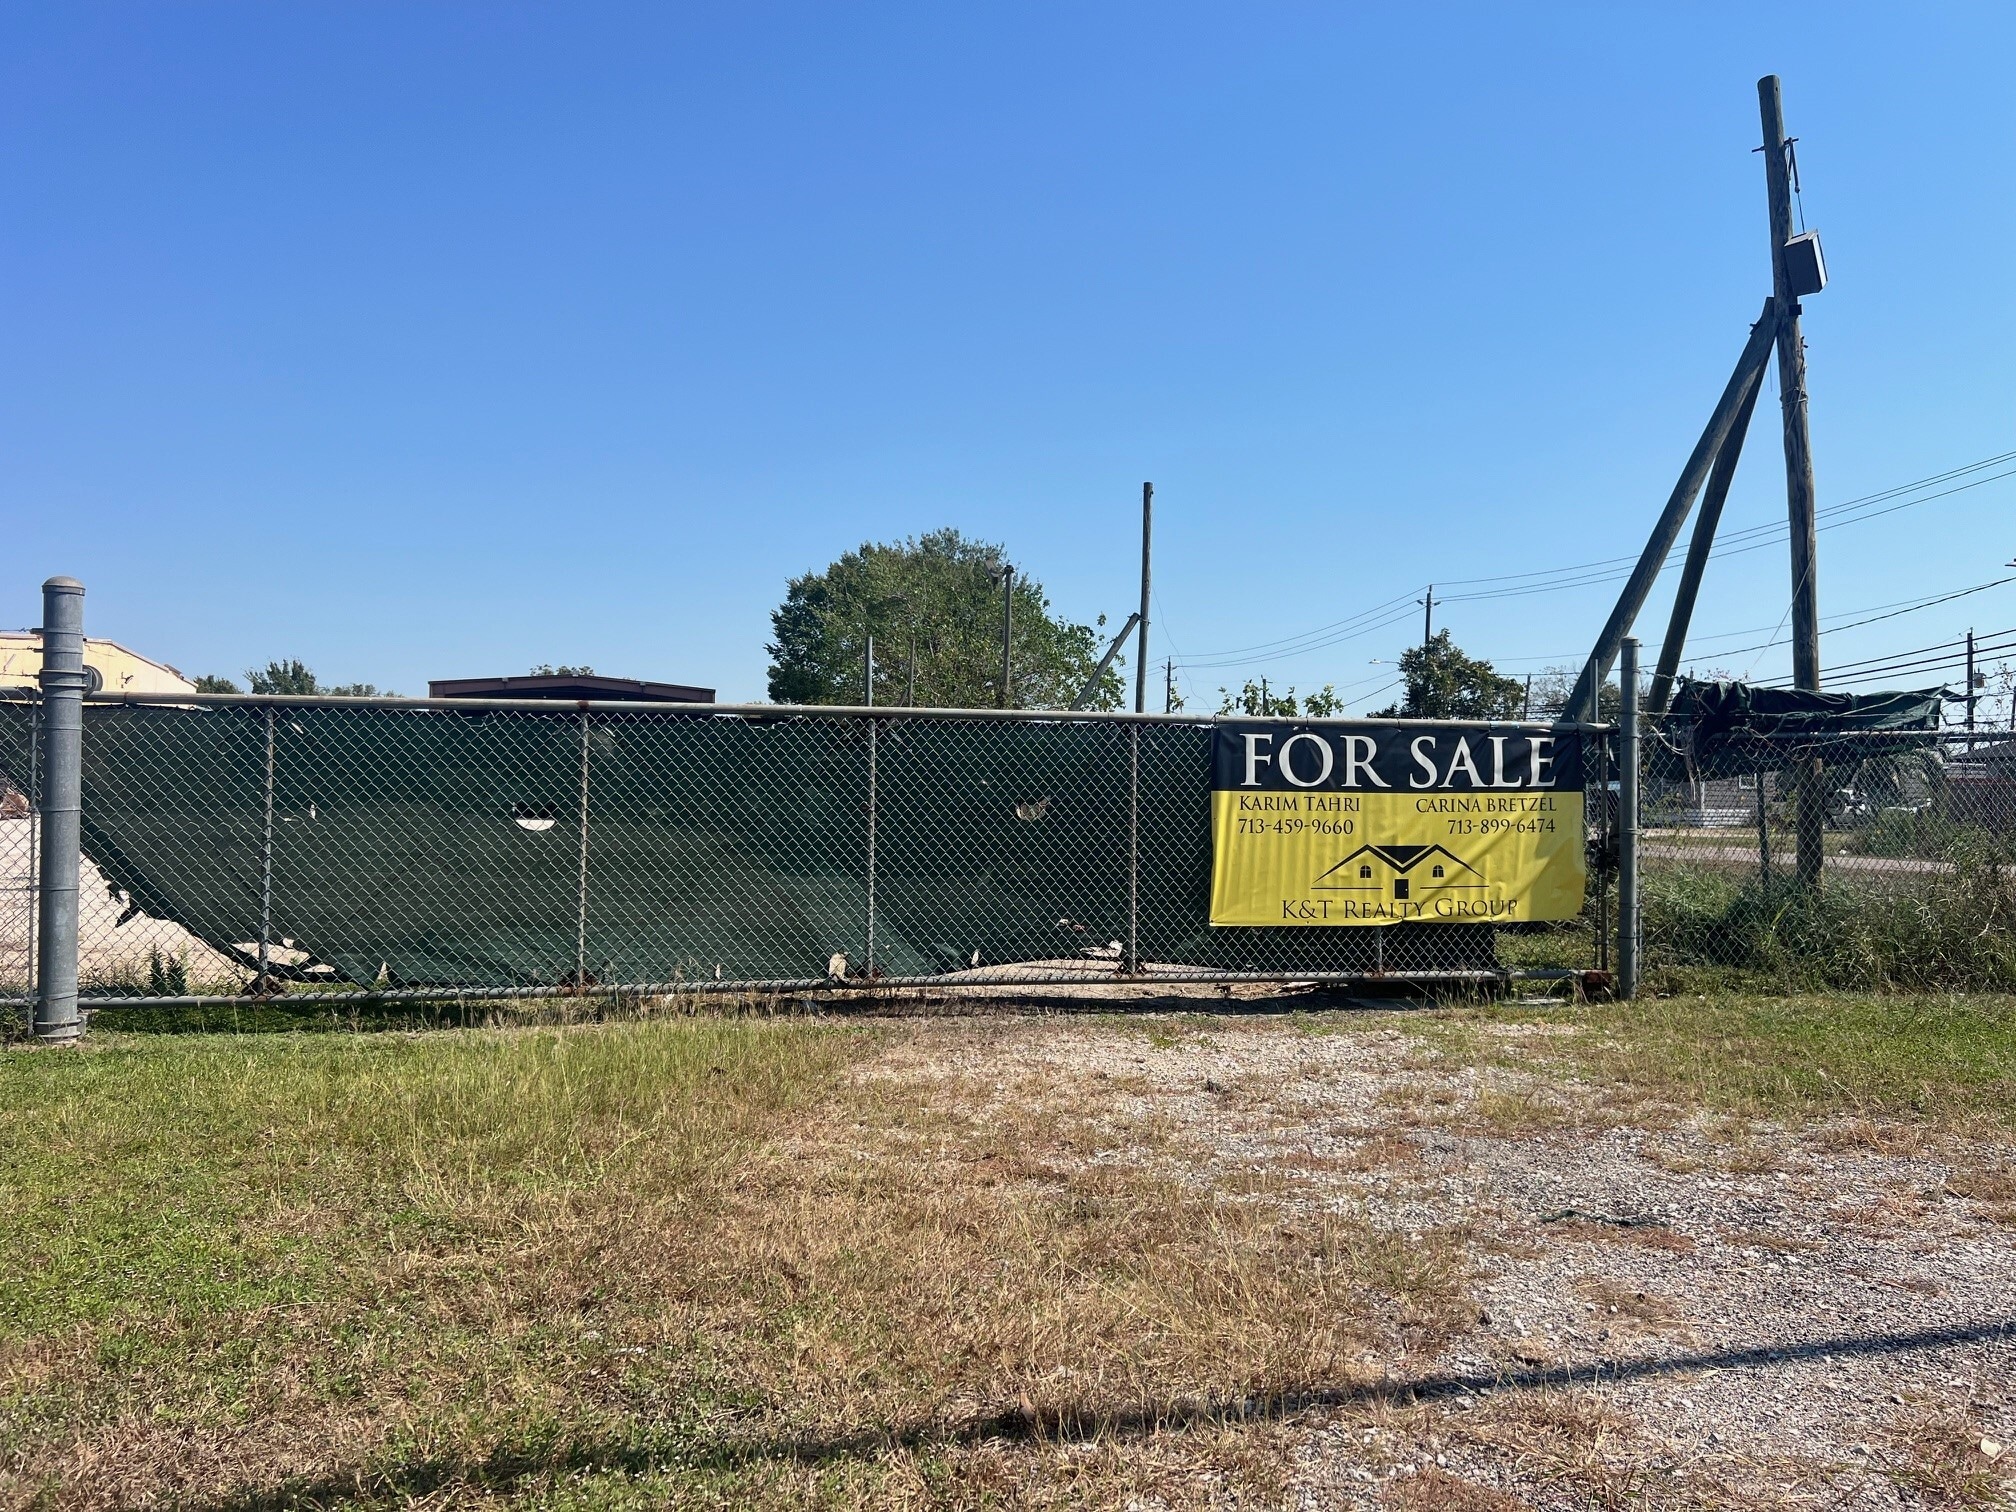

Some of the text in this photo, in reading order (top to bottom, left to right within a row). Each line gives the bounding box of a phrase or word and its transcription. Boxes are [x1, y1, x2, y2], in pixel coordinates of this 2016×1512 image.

[1239, 733, 1557, 788] FOR SALE
[1239, 795, 1361, 812] KARIM TAHRI
[1415, 797, 1557, 813] CARINA BRETZEL
[1238, 819, 1354, 835] 713-459-9660
[1447, 818, 1556, 834] 713-899-6474
[1282, 900, 1334, 919] K&T
